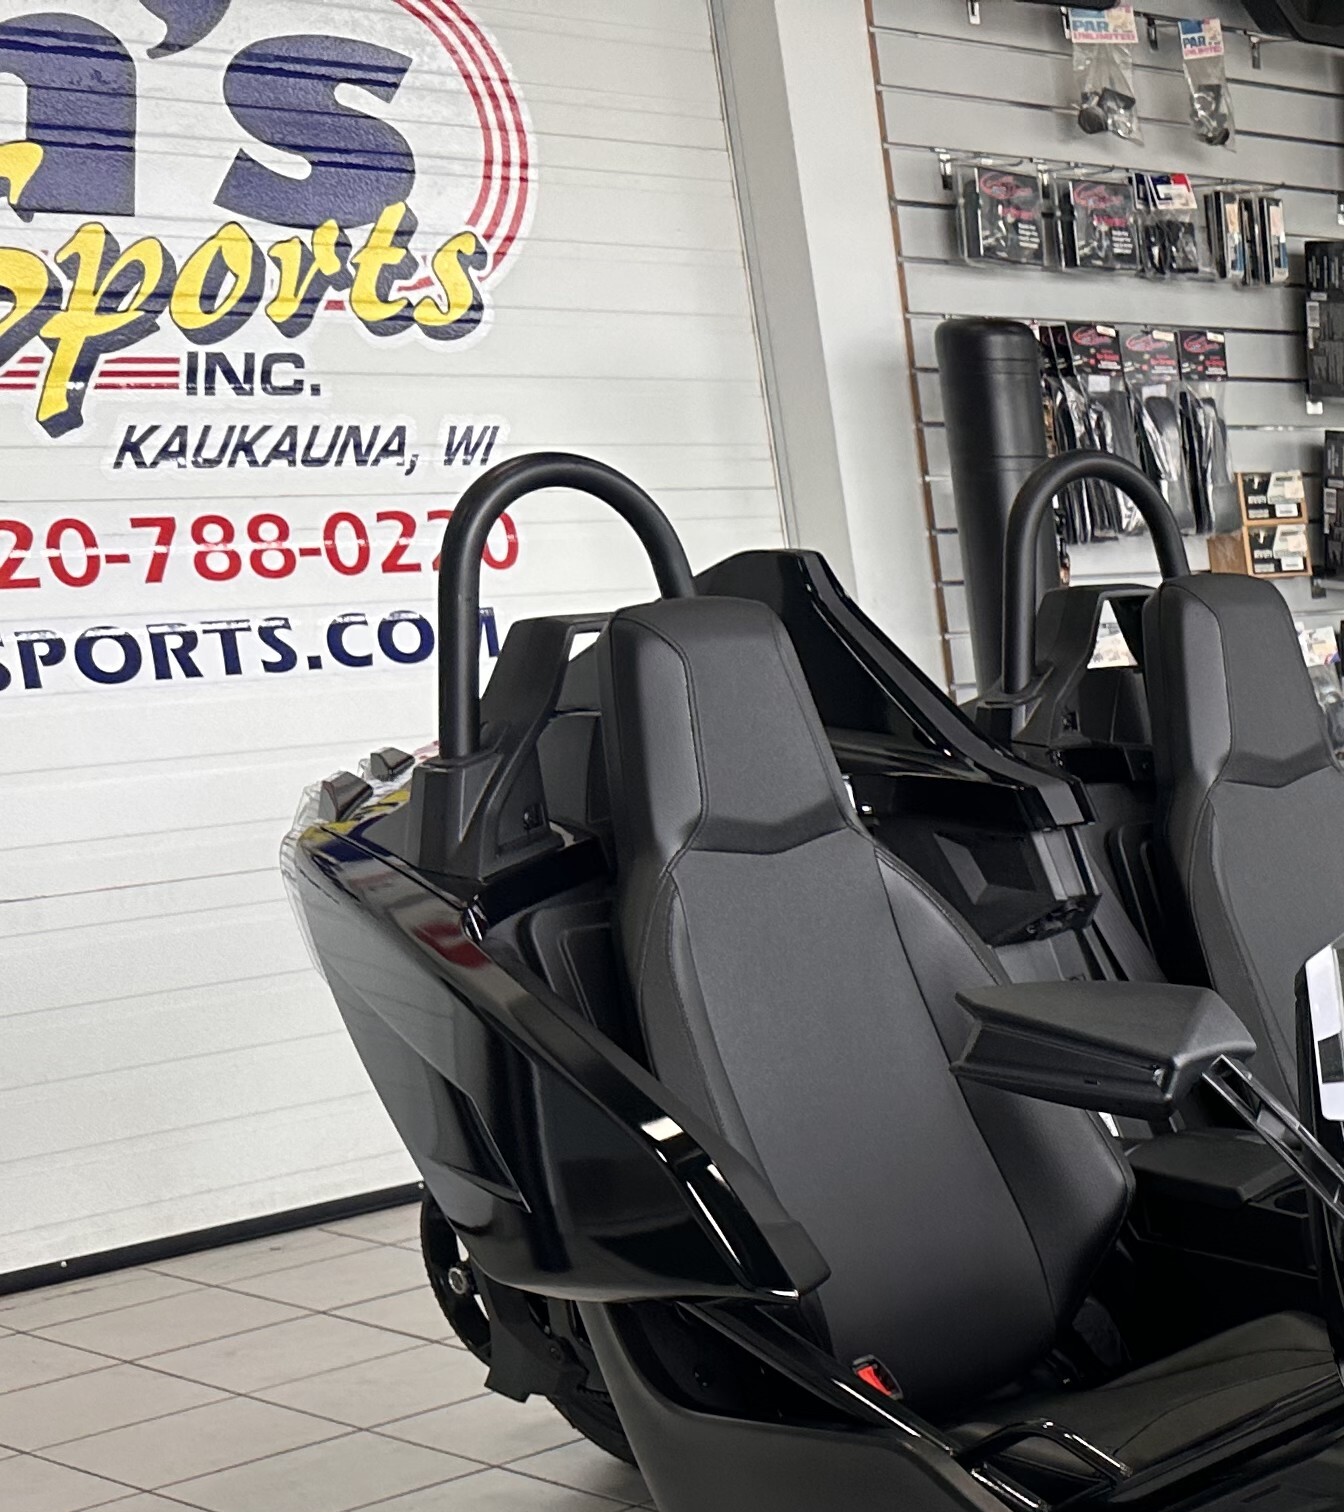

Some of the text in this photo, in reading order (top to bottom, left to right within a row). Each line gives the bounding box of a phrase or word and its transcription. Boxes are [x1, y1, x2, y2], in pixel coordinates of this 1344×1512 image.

[0, 142, 488, 438] ports
[186, 351, 322, 397] INC.
[113, 424, 501, 476] KAUKAUNA, WI
